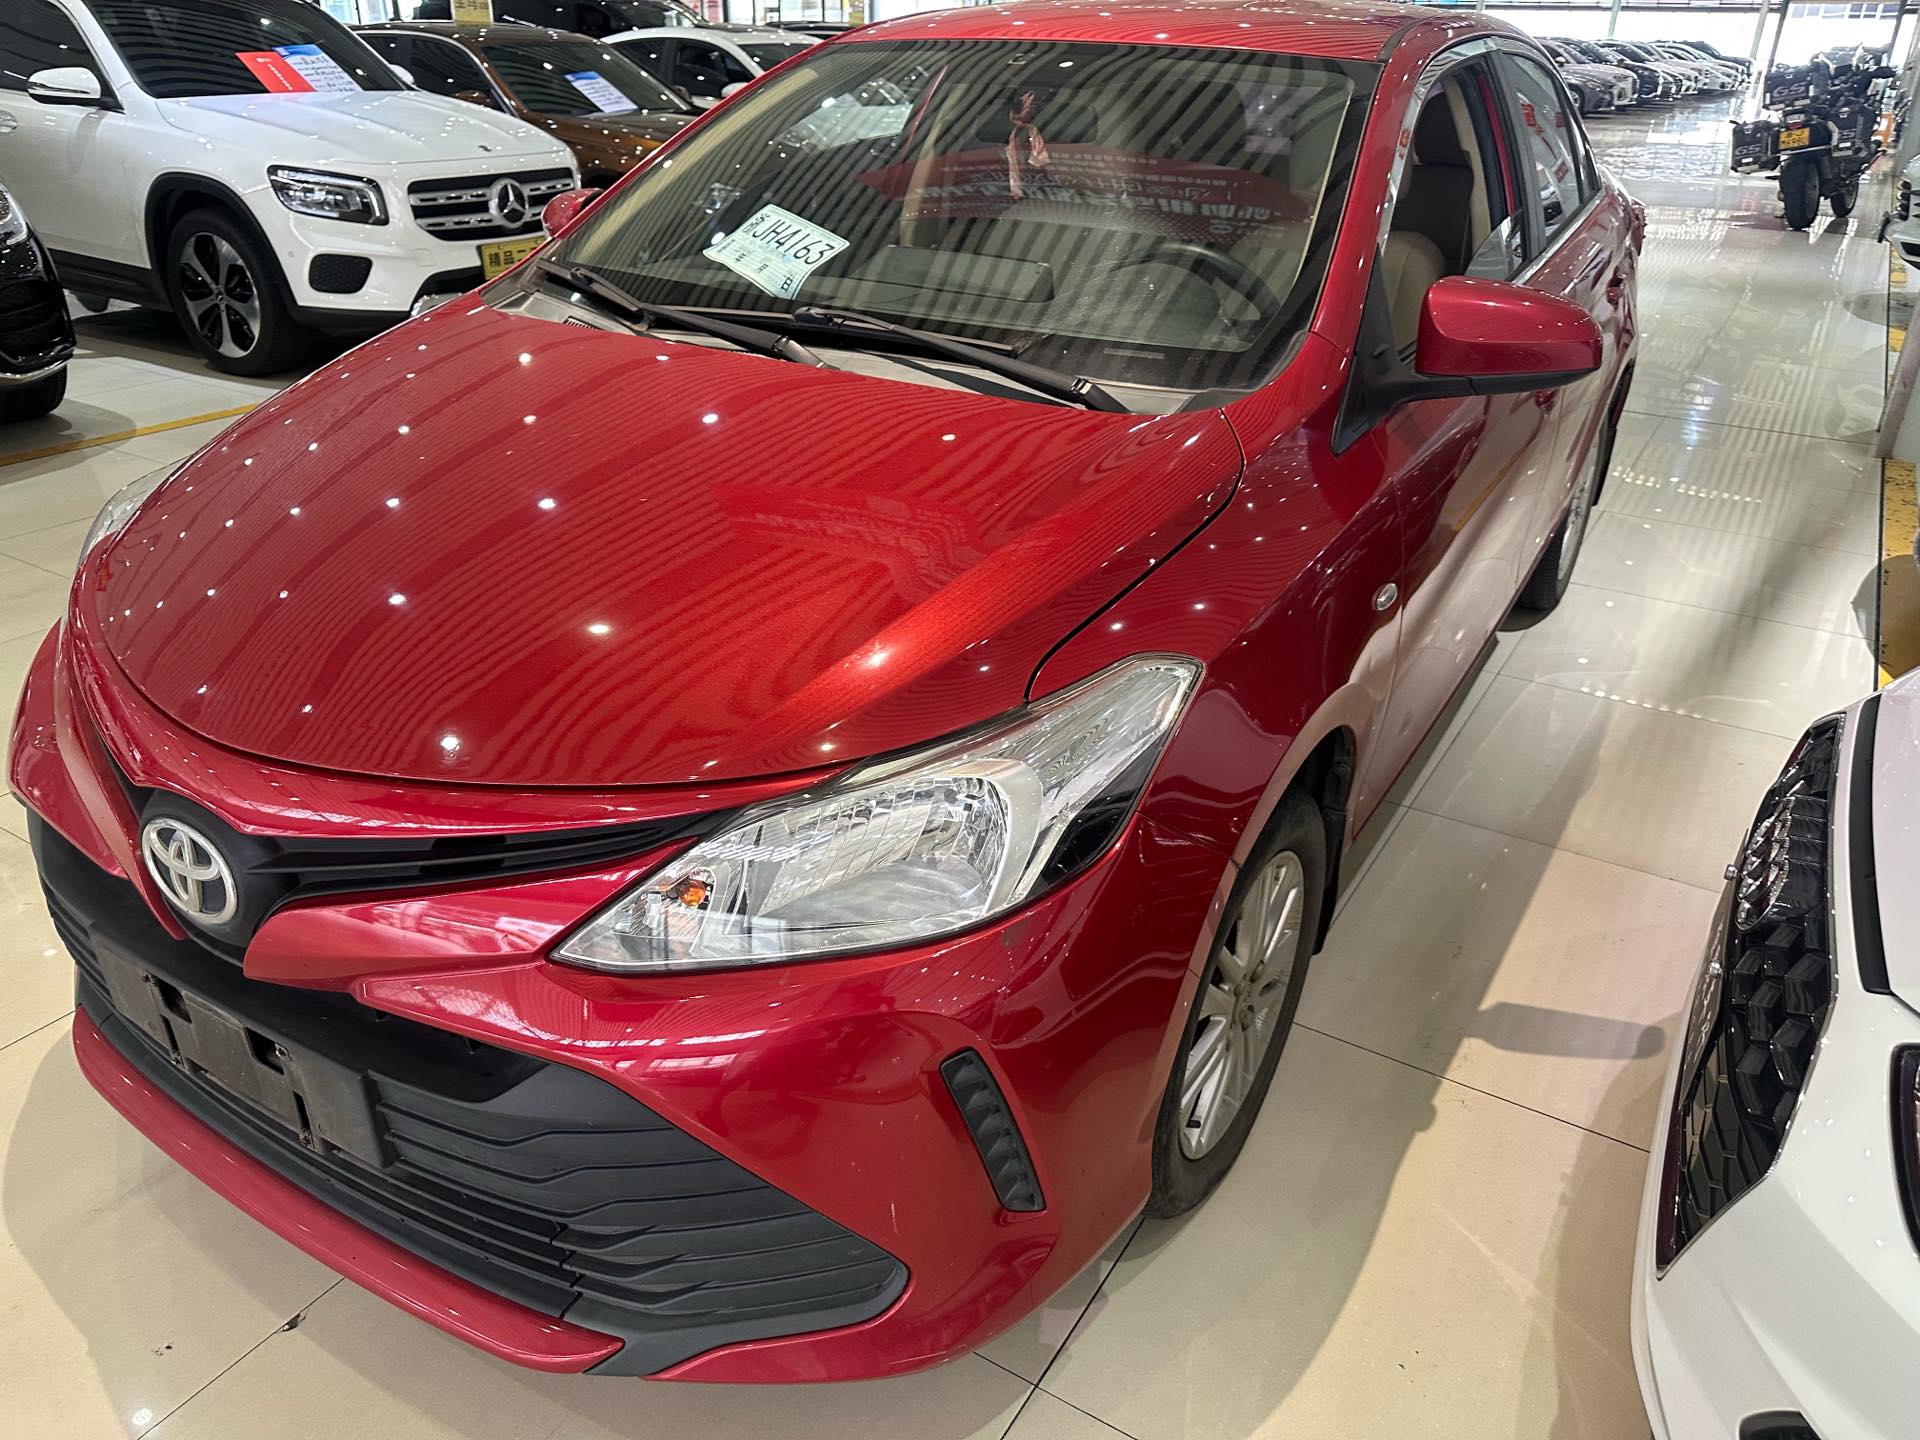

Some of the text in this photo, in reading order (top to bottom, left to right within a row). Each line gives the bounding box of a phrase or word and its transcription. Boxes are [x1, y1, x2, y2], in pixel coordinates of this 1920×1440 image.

[1772, 81, 1807, 98] GS
[1734, 144, 1761, 156] GS
[488, 247, 538, 267] 精品二
